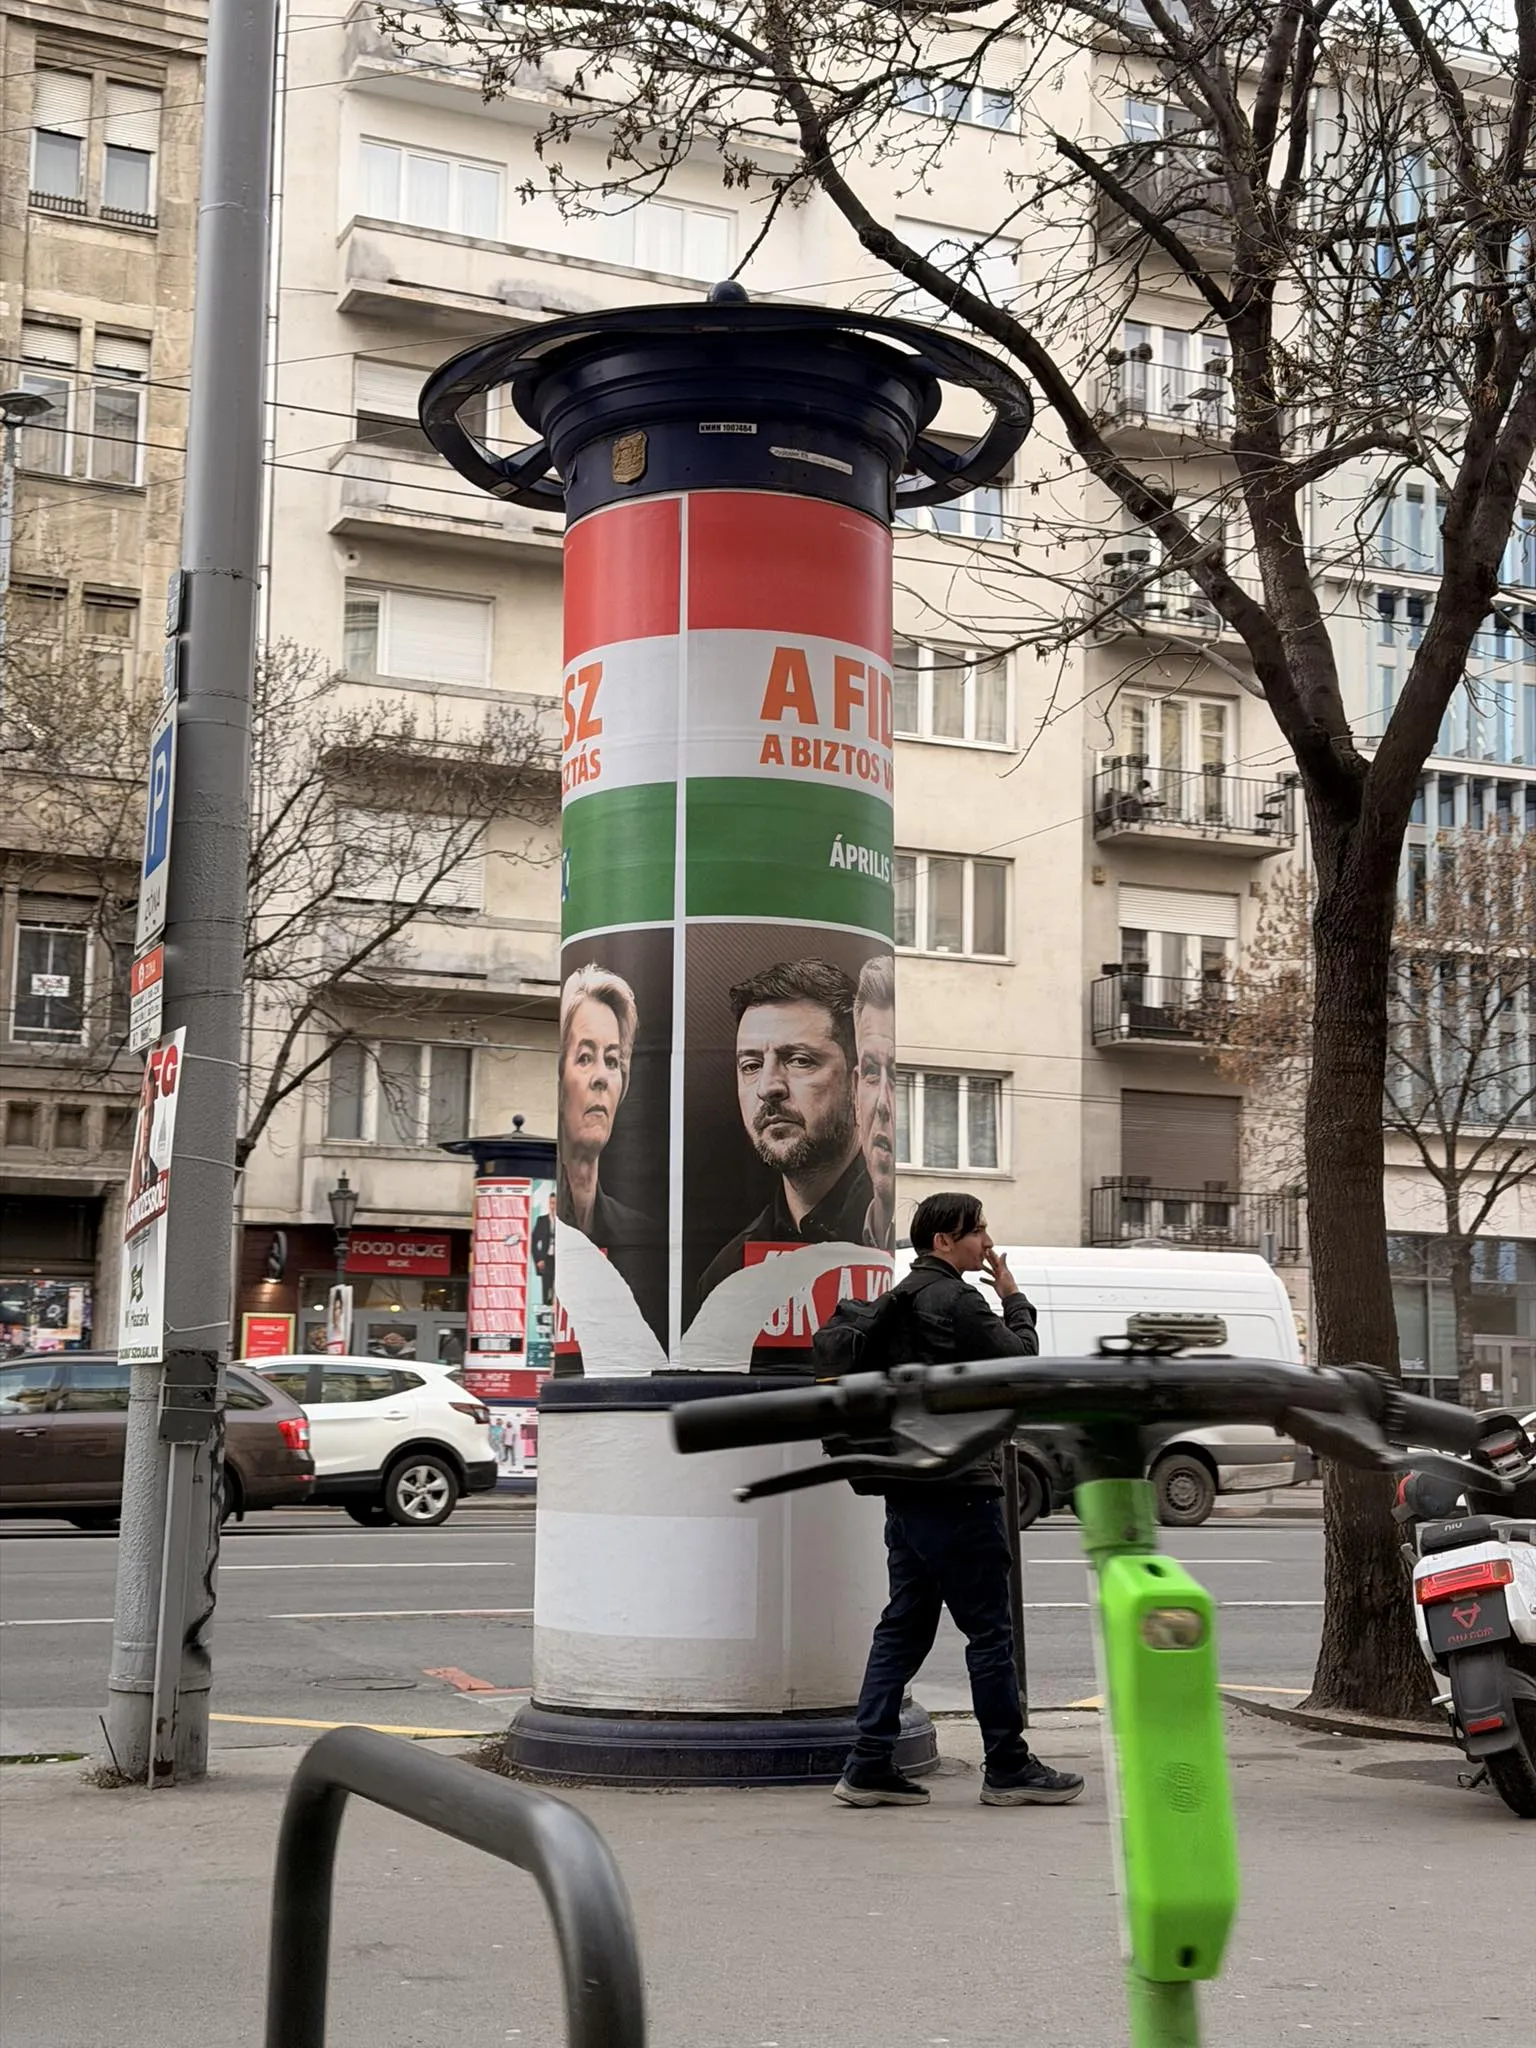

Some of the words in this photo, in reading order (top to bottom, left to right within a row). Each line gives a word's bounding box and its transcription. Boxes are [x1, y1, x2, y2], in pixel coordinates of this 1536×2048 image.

[760, 647, 819, 725] A
[759, 734, 785, 765] A
[791, 736, 880, 784] BIZTOS
[151, 750, 167, 856] P
[829, 833, 890, 883] ÁPRILIS
[352, 1241, 395, 1255] FOOD
